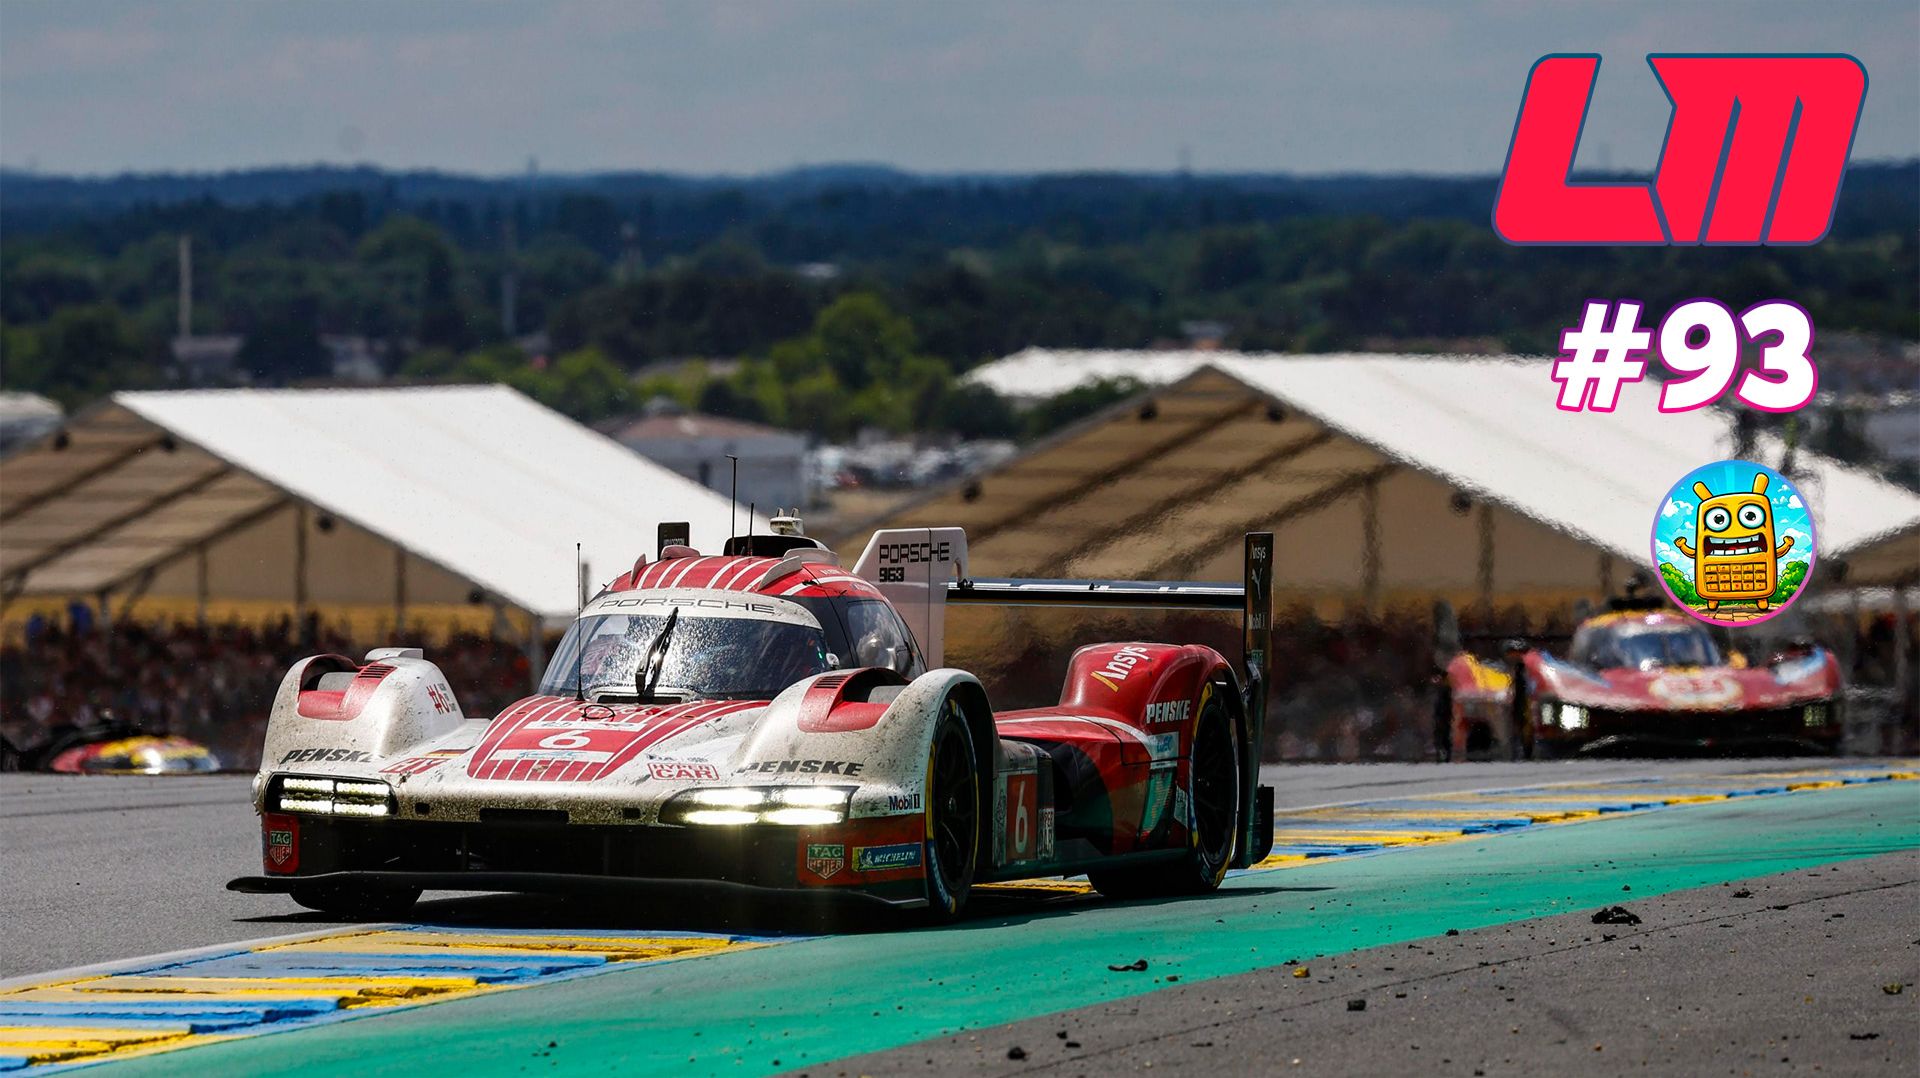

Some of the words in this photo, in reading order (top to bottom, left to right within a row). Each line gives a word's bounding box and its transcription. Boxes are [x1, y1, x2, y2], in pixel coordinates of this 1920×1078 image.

[879, 542, 950, 564] PORSCHE
[879, 567, 904, 582] 963
[599, 598, 775, 614] PORSCHE
[1090, 646, 1151, 693] Ansys
[1146, 699, 1191, 724] PENSKE
[538, 730, 591, 749] 6
[656, 769, 713, 779] CAR
[737, 759, 864, 777] PENSKE
[1015, 780, 1028, 853] 6
[271, 833, 290, 844] TAG
[811, 847, 842, 857] TAG
[874, 850, 916, 866] MICHELIN
[809, 859, 842, 875] HEUER
